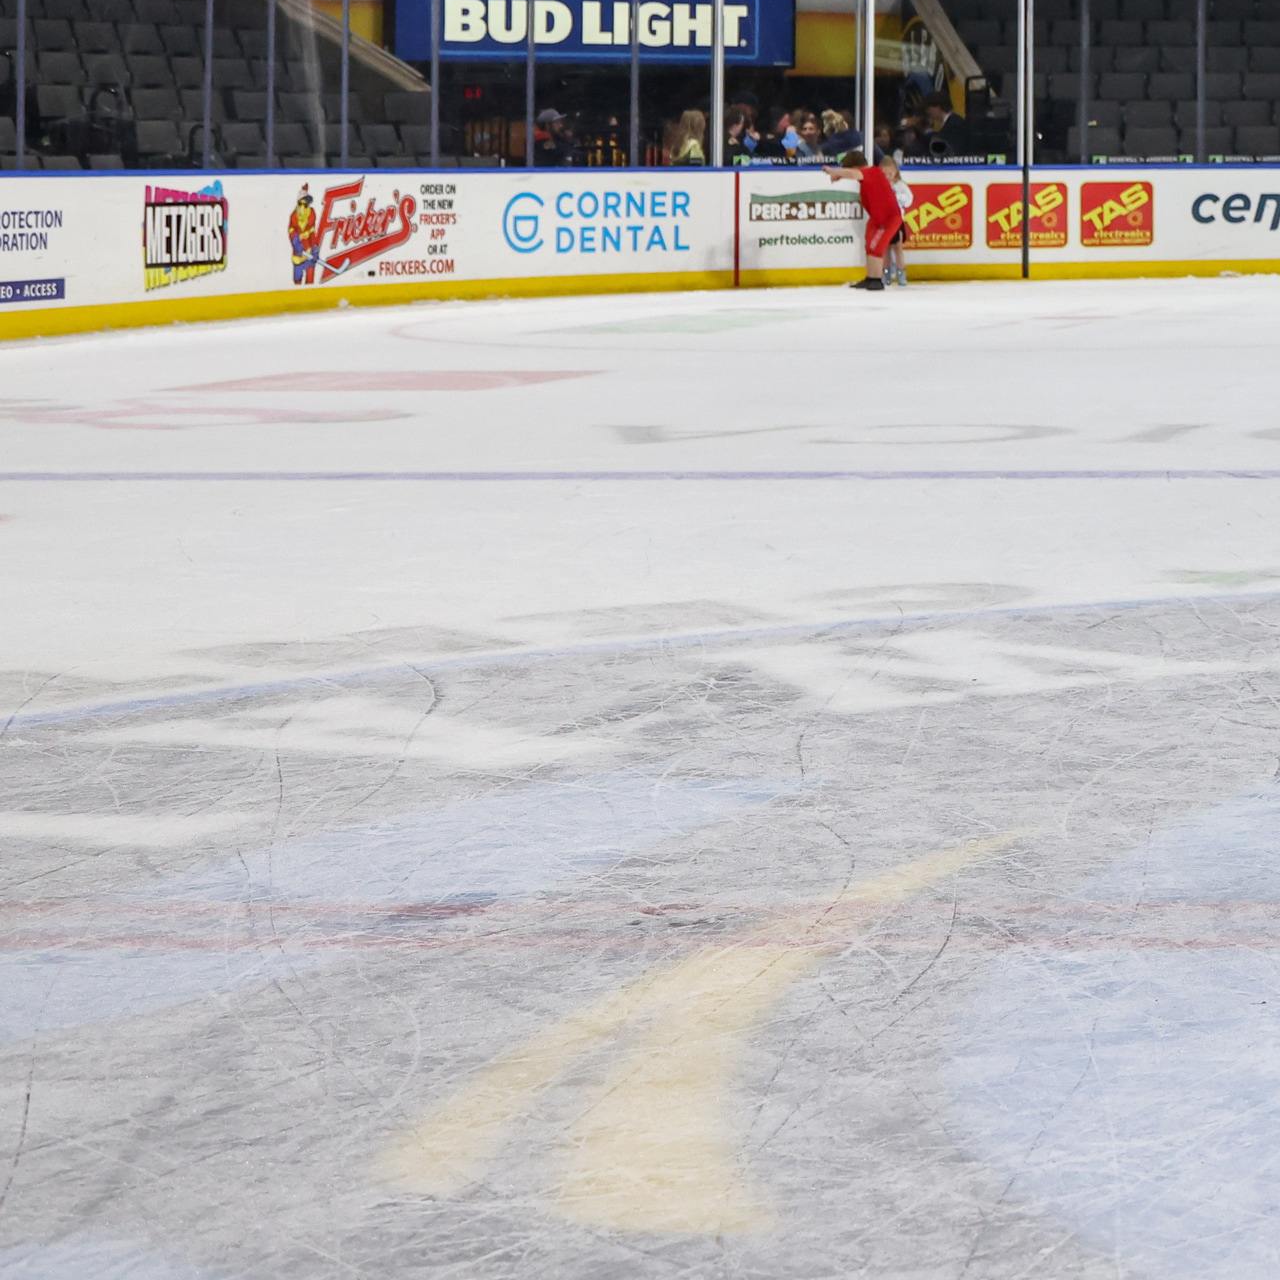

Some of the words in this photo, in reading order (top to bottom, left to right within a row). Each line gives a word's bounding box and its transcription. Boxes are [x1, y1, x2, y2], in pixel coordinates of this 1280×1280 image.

[580, 0, 748, 48] LIGHT
[904, 156, 931, 164] NEWAL
[420, 184, 444, 195] ORDER
[444, 184, 457, 194] ON
[422, 200, 436, 210] THE
[436, 199, 453, 210] NEW
[554, 190, 692, 220] CORNER
[903, 185, 969, 233] TAS
[988, 184, 1064, 233] TAS
[1082, 183, 1149, 231] TAS
[1, 210, 63, 229] OTECTION
[419, 213, 457, 225] FRICKER'S
[2, 233, 48, 252] RATION
[145, 204, 224, 265] METZGERS
[430, 229, 446, 241] APP
[554, 225, 692, 254] DENTAL
[758, 233, 854, 248] perftoledo.com
[1000, 230, 1066, 241] elecronics
[427, 245, 438, 256] OR
[439, 244, 448, 255] AT
[379, 259, 455, 276] FRICKERS.COM
[23, 282, 58, 298] ACCESS
